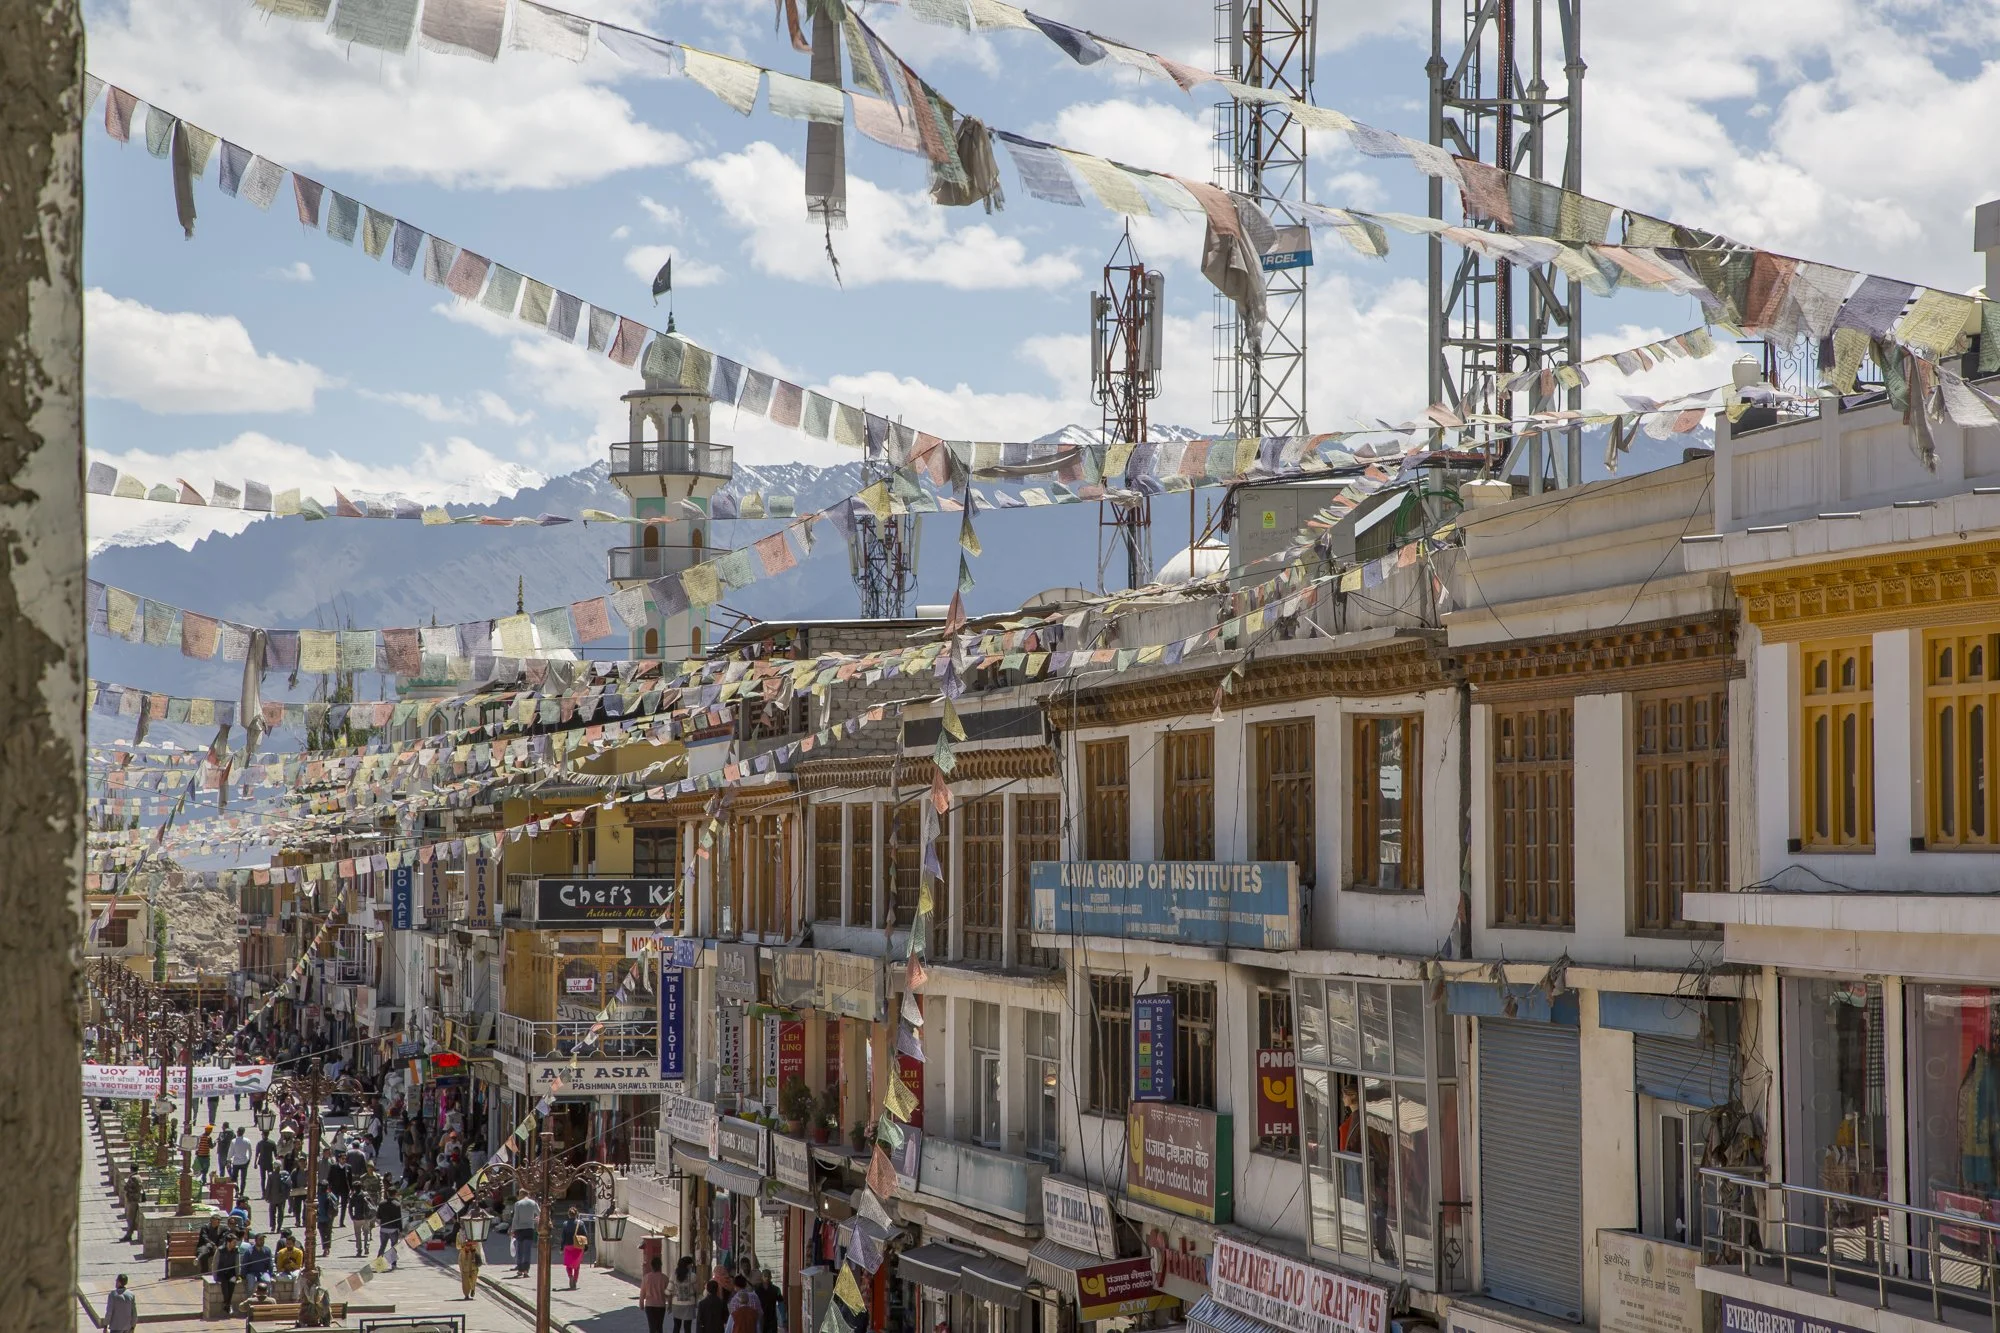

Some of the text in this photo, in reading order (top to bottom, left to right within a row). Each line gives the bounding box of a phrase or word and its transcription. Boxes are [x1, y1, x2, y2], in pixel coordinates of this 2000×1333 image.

[1262, 253, 1298, 266] IRCEL
[1061, 863, 1263, 894] KAWA GROUP OF INSTITUTES
[559, 884, 633, 907] Chef's
[397, 892, 407, 928] CAFE
[426, 907, 445, 915] CAFE
[586, 908, 622, 918] Authentic
[625, 908, 645, 918] Multi
[666, 975, 679, 983] THE
[783, 1033, 800, 1042] LEH
[668, 1026, 677, 1070] LOTUS
[781, 1043, 801, 1052] LING
[1155, 1006, 1164, 1093] RESTAURANT
[1259, 1051, 1295, 1068] PNB
[594, 1067, 650, 1079] ASIA
[572, 1082, 617, 1091] PASHMINA
[618, 1082, 647, 1090] SHAWLS
[1264, 1122, 1292, 1135] LEH
[1144, 1162, 1208, 1197] punjab national bank
[1045, 1190, 1059, 1216] THE
[1061, 1195, 1088, 1224] TRIBAL
[1108, 1279, 1153, 1296] punjab nation
[1218, 1243, 1381, 1333] SHANGLOO CRAFTS
[1119, 1300, 1148, 1313] ATM
[1725, 1303, 1796, 1333] EVERGREEN
